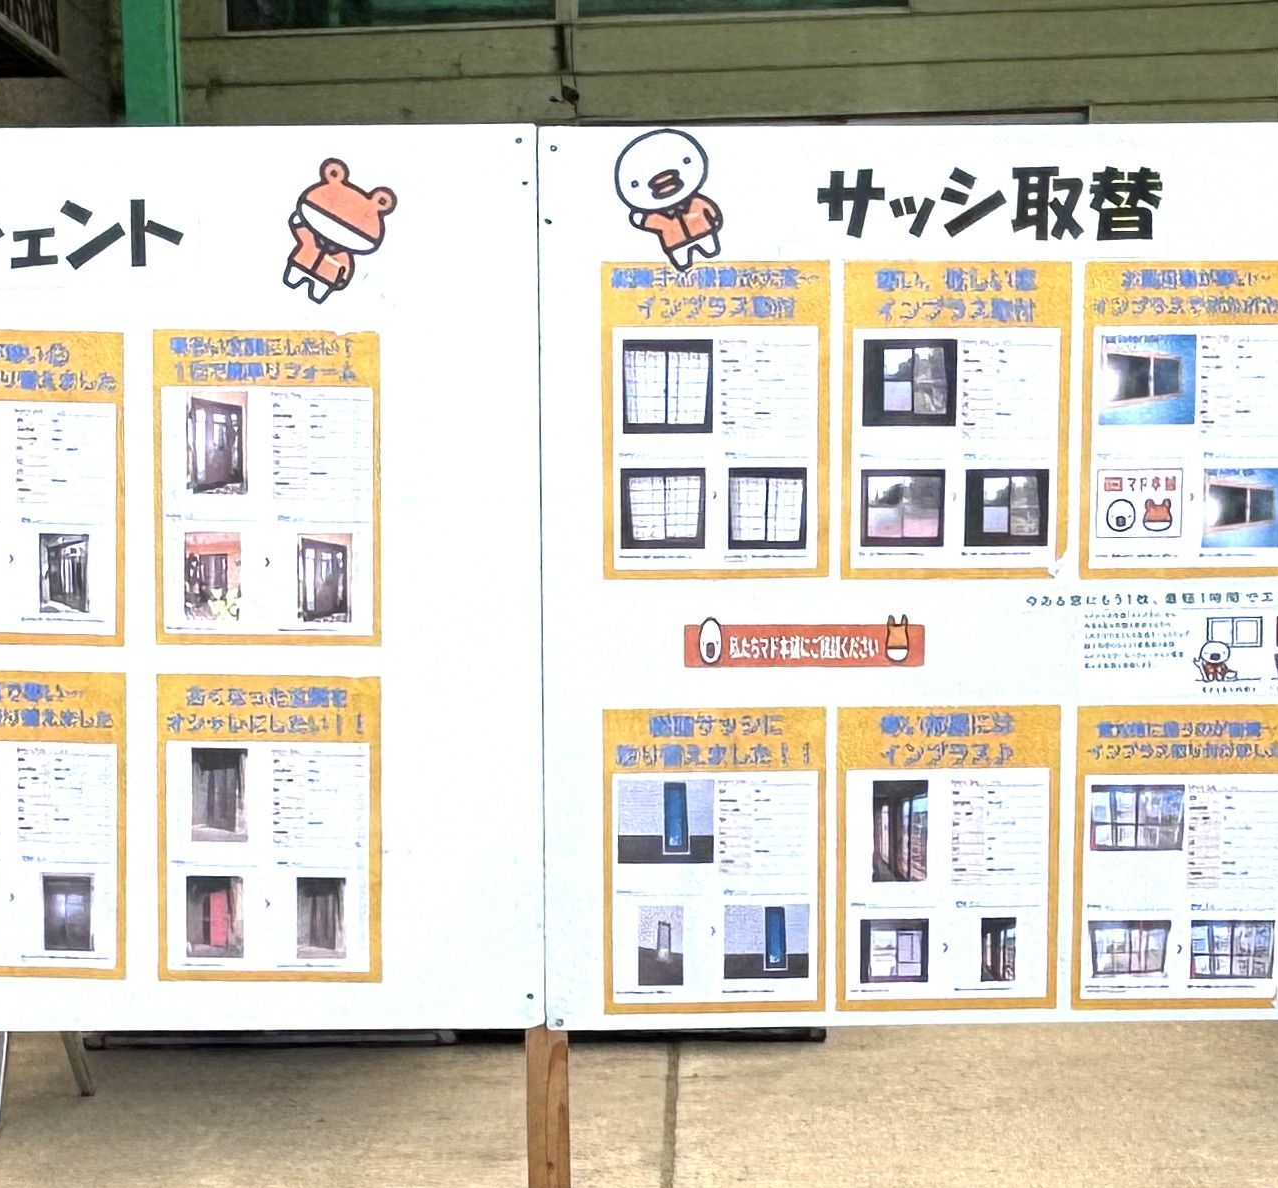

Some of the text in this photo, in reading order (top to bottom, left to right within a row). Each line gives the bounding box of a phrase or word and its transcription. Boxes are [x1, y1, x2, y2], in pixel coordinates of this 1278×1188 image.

[818, 166, 1162, 240] サッシ取替
